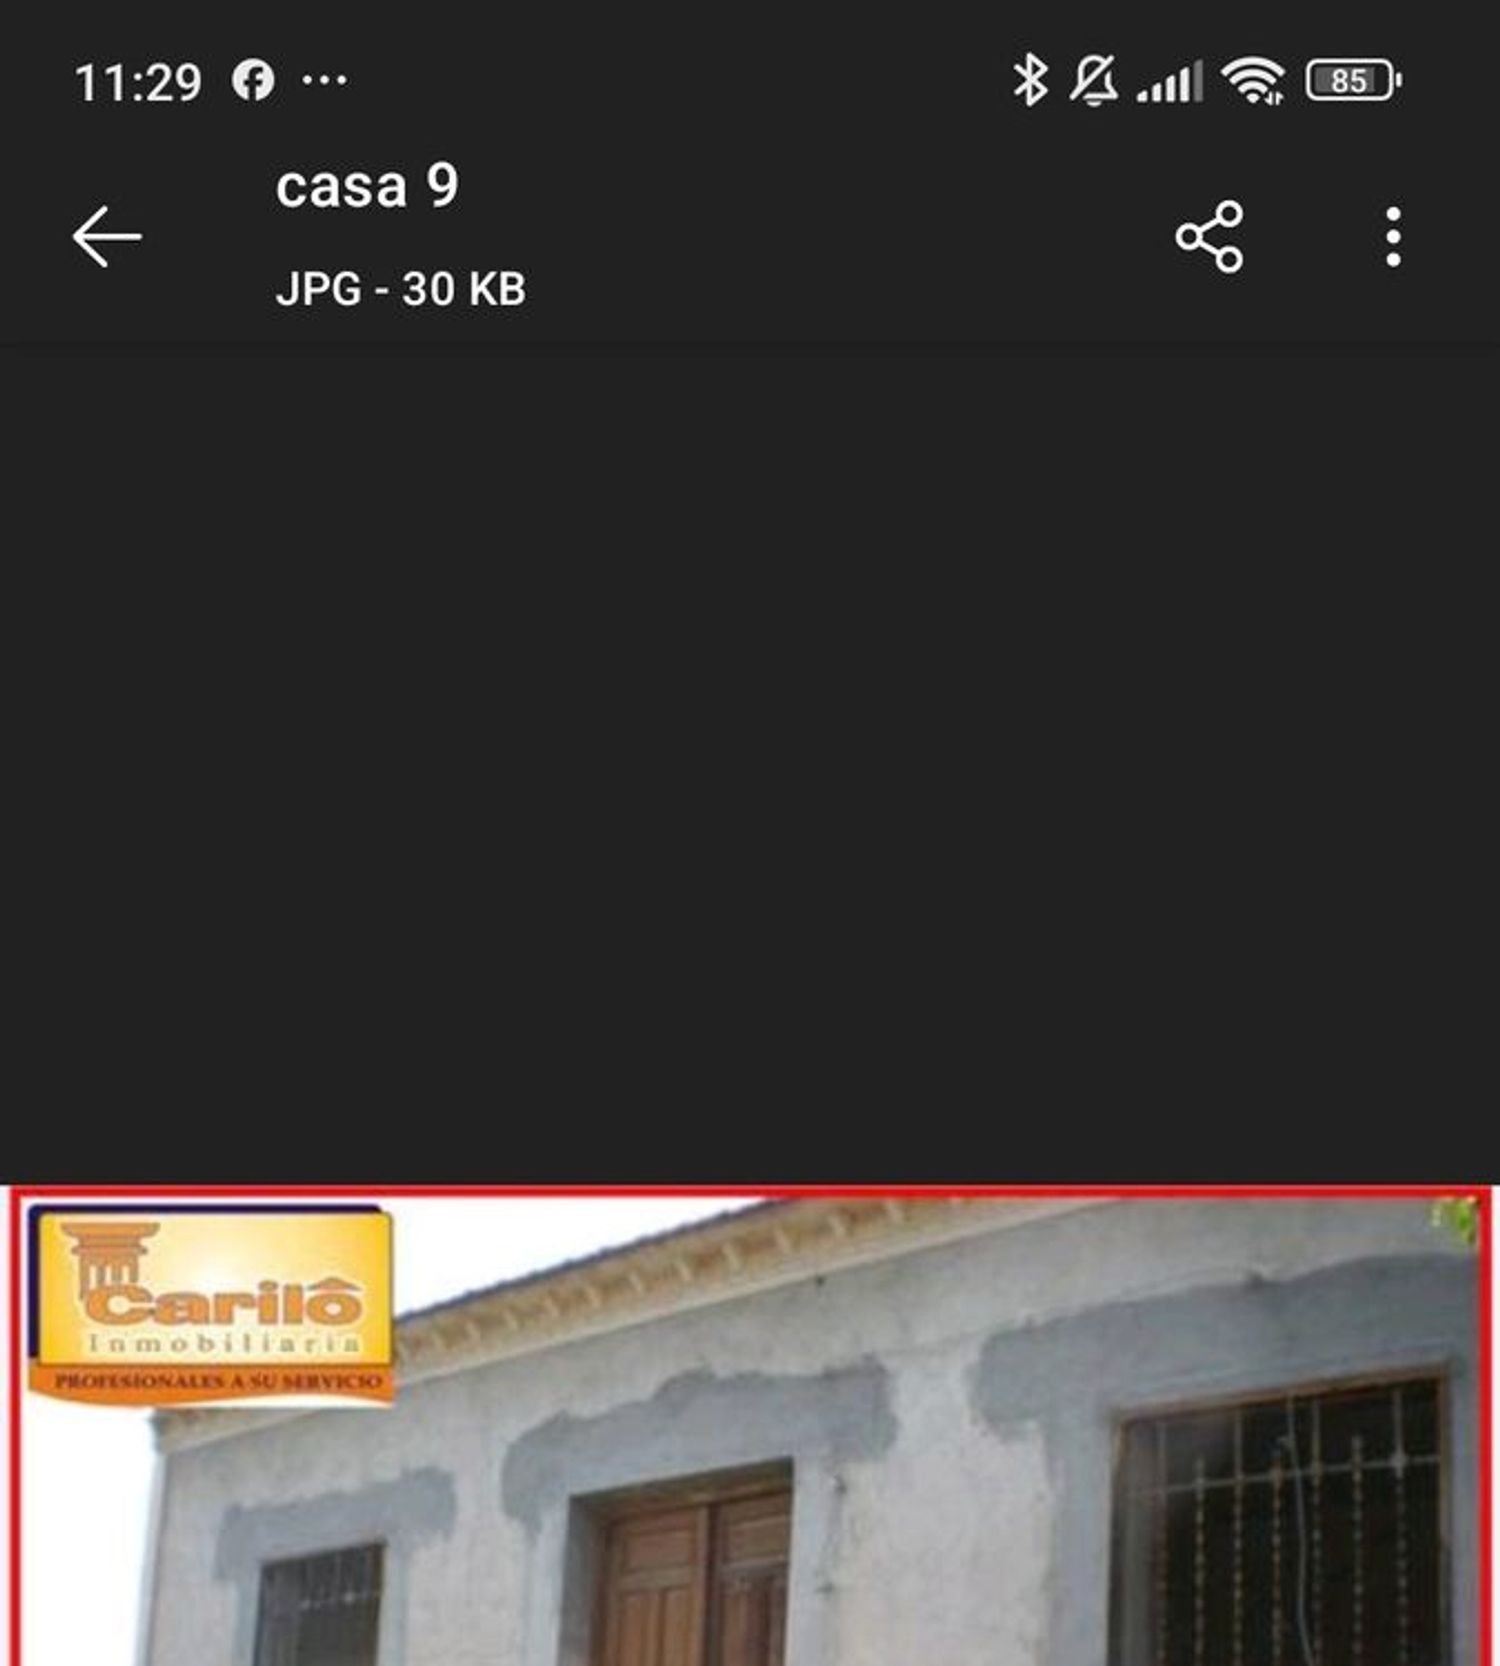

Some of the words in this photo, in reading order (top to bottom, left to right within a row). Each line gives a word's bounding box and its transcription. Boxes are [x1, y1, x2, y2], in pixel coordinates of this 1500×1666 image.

[76, 63, 201, 101] 11:29
[1333, 69, 1366, 92] 85
[278, 173, 406, 207] casa
[428, 162, 457, 207] 9
[276, 271, 360, 305] JPG
[403, 271, 454, 305] 30
[471, 271, 525, 305] KB
